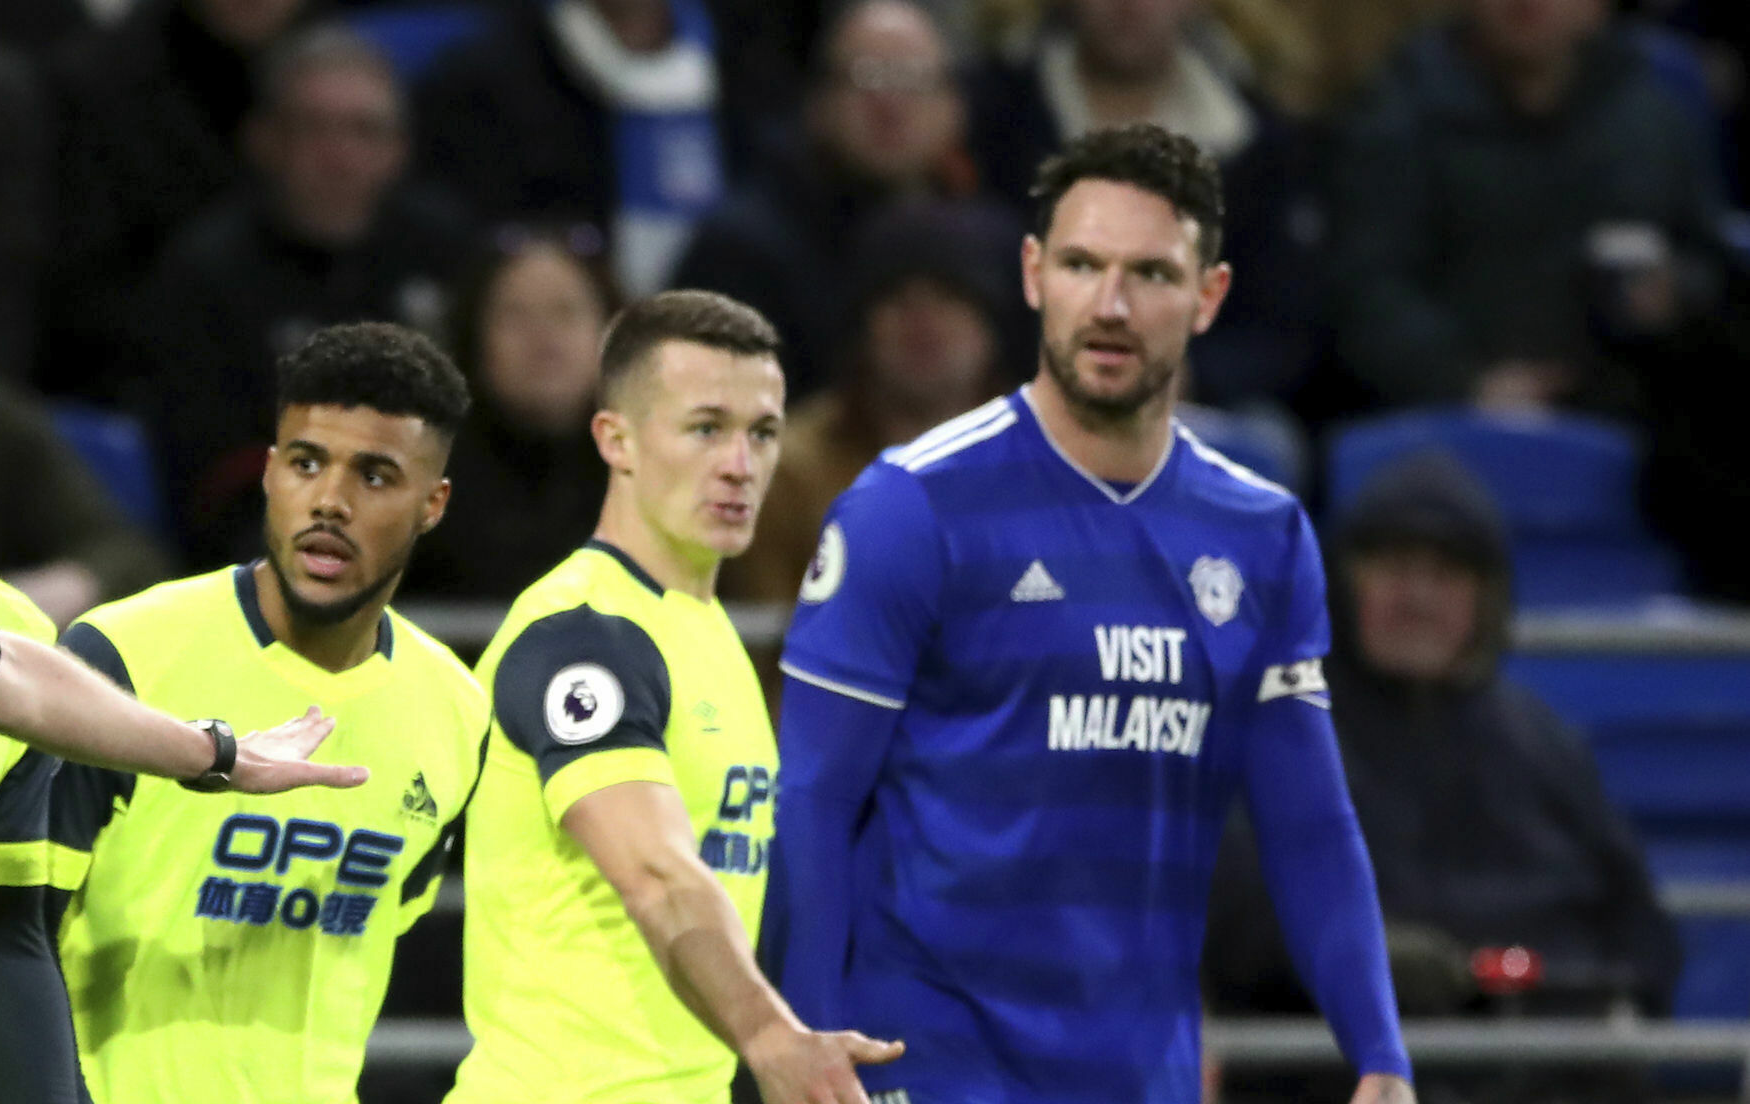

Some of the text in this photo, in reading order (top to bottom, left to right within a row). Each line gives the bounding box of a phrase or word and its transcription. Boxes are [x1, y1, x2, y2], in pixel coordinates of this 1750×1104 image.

[1094, 624, 1187, 685] VISIT
[718, 765, 780, 822] OP
[212, 813, 405, 888] OPE
